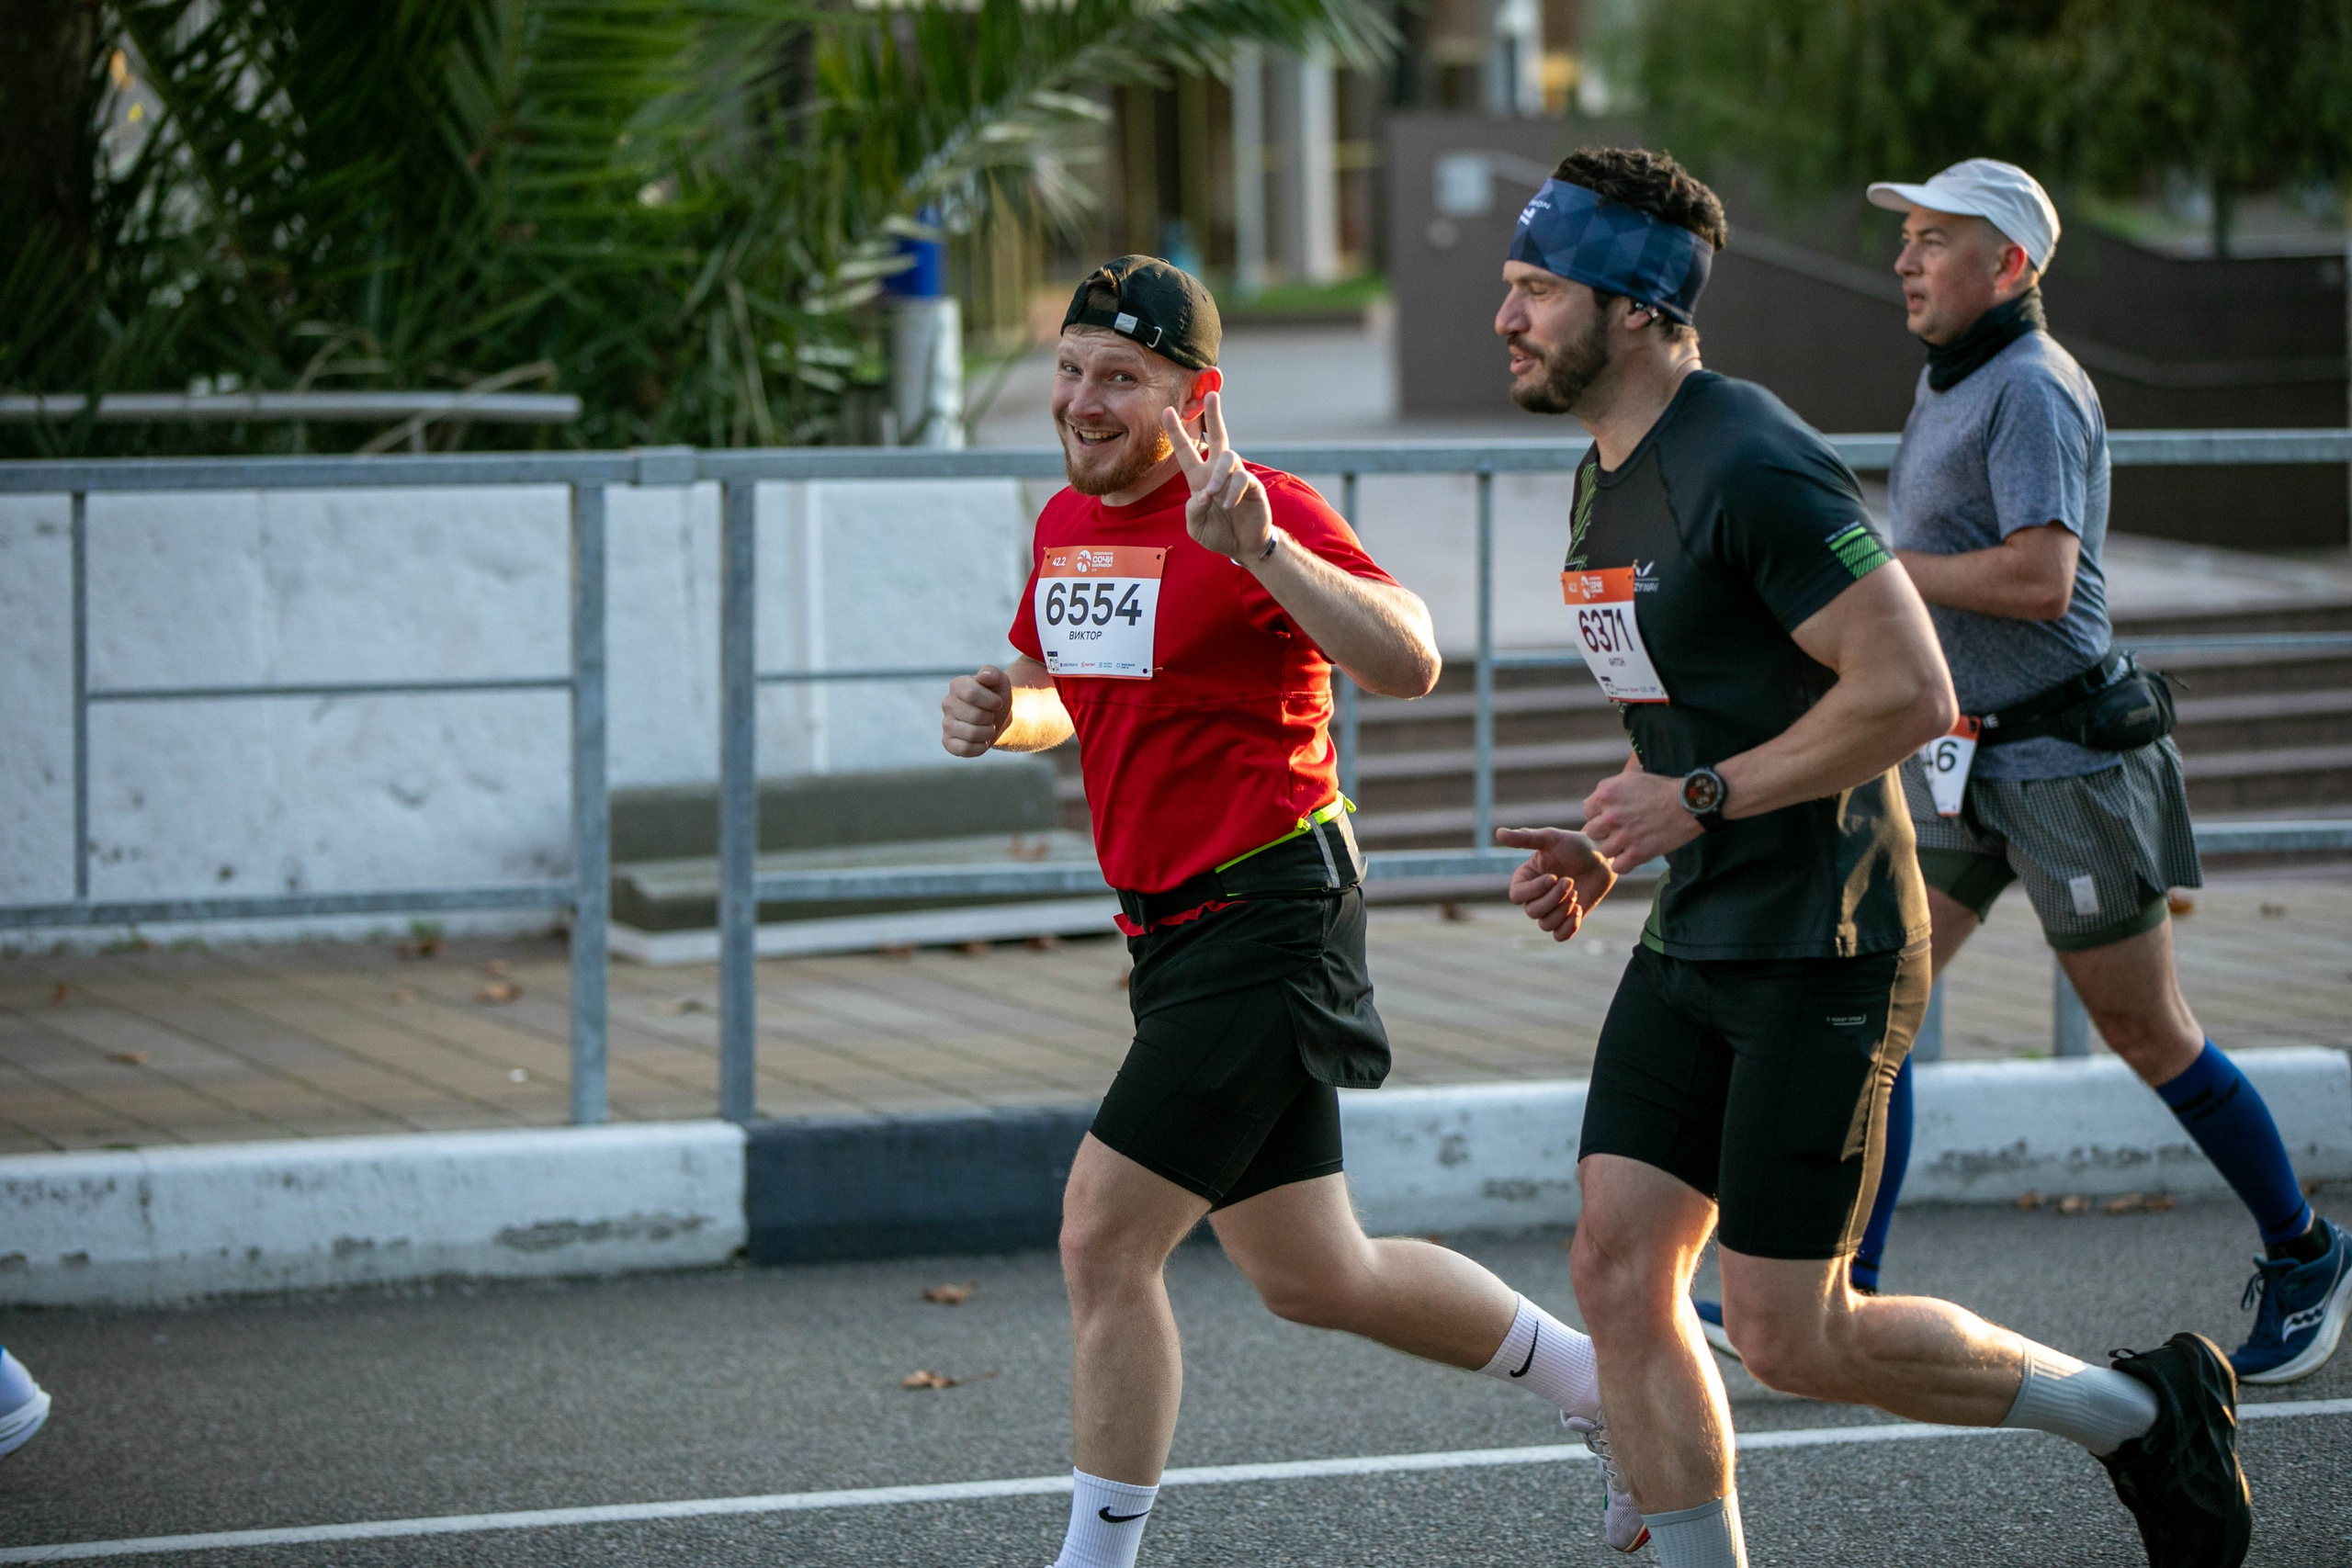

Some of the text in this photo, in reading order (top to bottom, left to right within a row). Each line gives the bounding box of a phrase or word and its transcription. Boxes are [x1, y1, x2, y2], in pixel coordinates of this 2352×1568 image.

[1052, 557, 1067, 567] 42.2
[1091, 555, 1114, 563] СОЧИ
[1046, 582, 1143, 626] 6554
[1069, 630, 1102, 640] ВИКТОР
[1578, 608, 1634, 653] 6371
